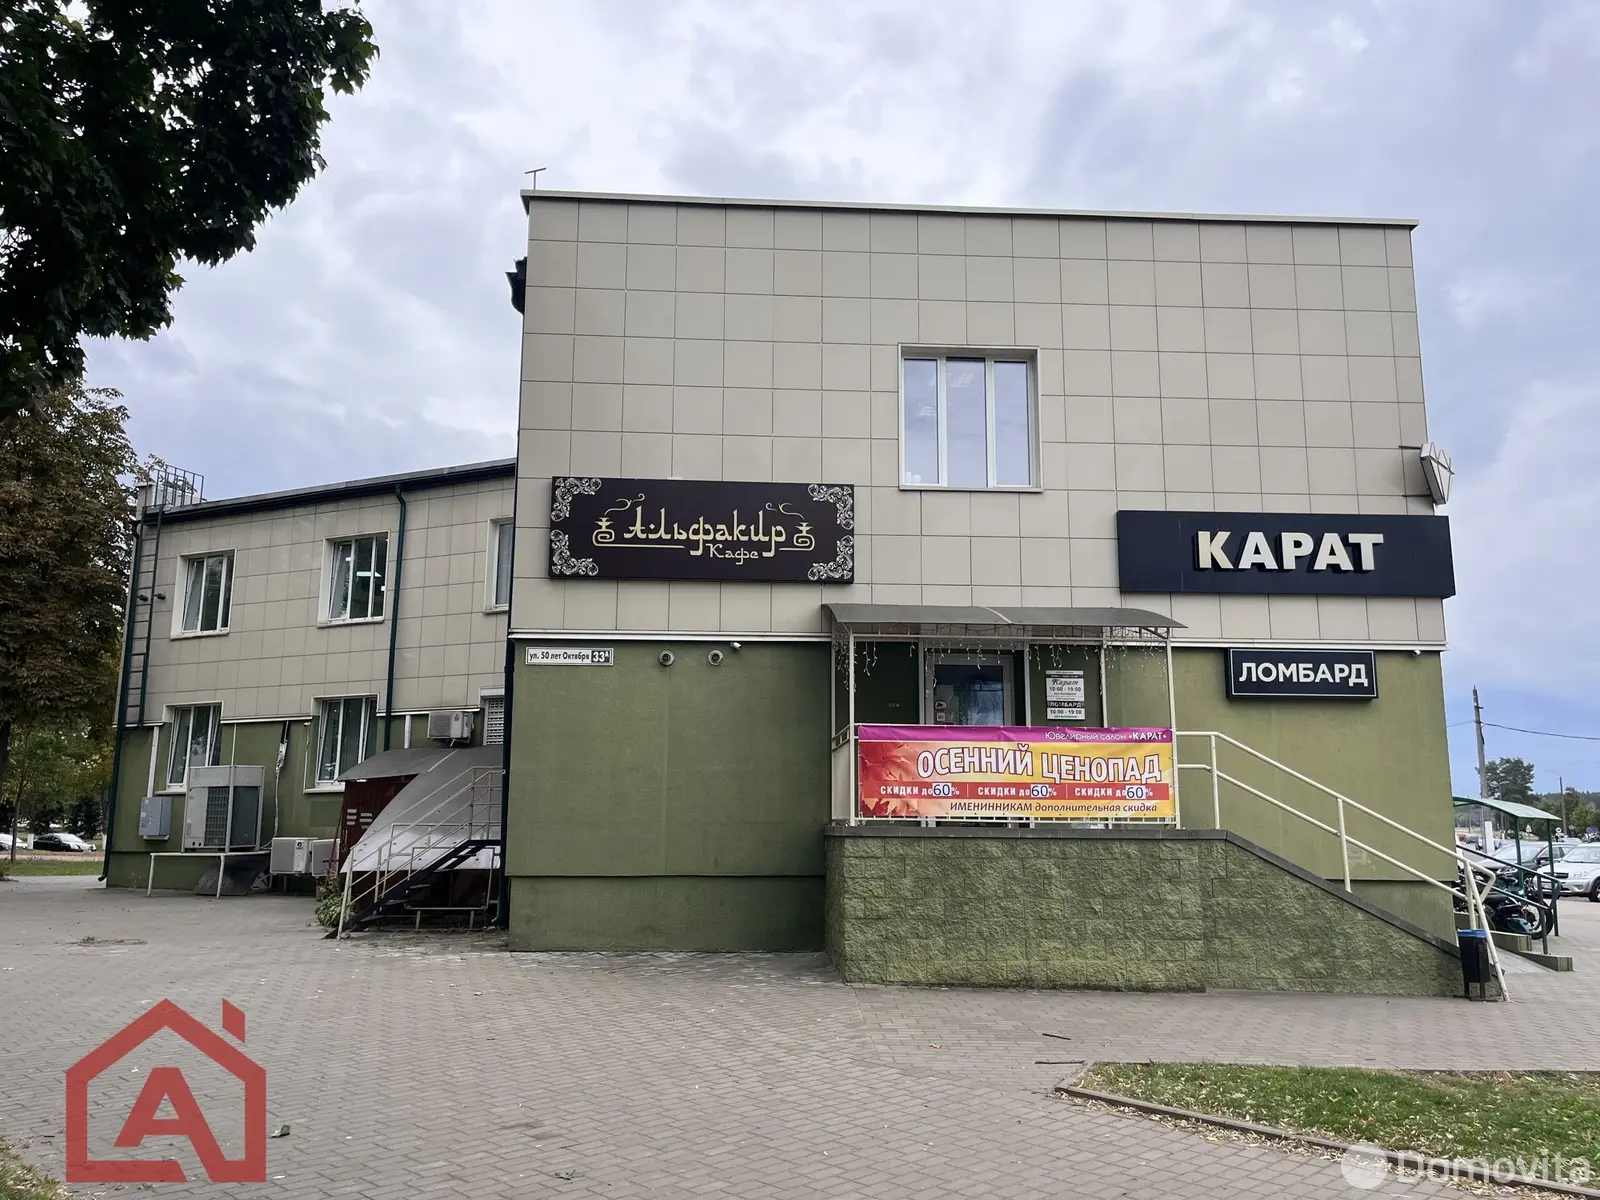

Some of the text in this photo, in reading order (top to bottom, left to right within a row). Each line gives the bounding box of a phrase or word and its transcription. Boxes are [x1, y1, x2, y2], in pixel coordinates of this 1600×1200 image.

[623, 505, 787, 558] Альфакир
[705, 543, 759, 565] Кафе
[1196, 530, 1384, 571] КАРАТ
[529, 650, 609, 663] ул. 50 лет Октября 33А
[1238, 661, 1369, 687] ЛОМБАРД
[1045, 731, 1099, 742] Ювелирный
[1100, 733, 1127, 741] салон
[917, 743, 1162, 784] ОСЕННИЙ ЦЕНОПАД
[950, 802, 1157, 813] ИМЕНИННИКАМ дополнительная скидка
